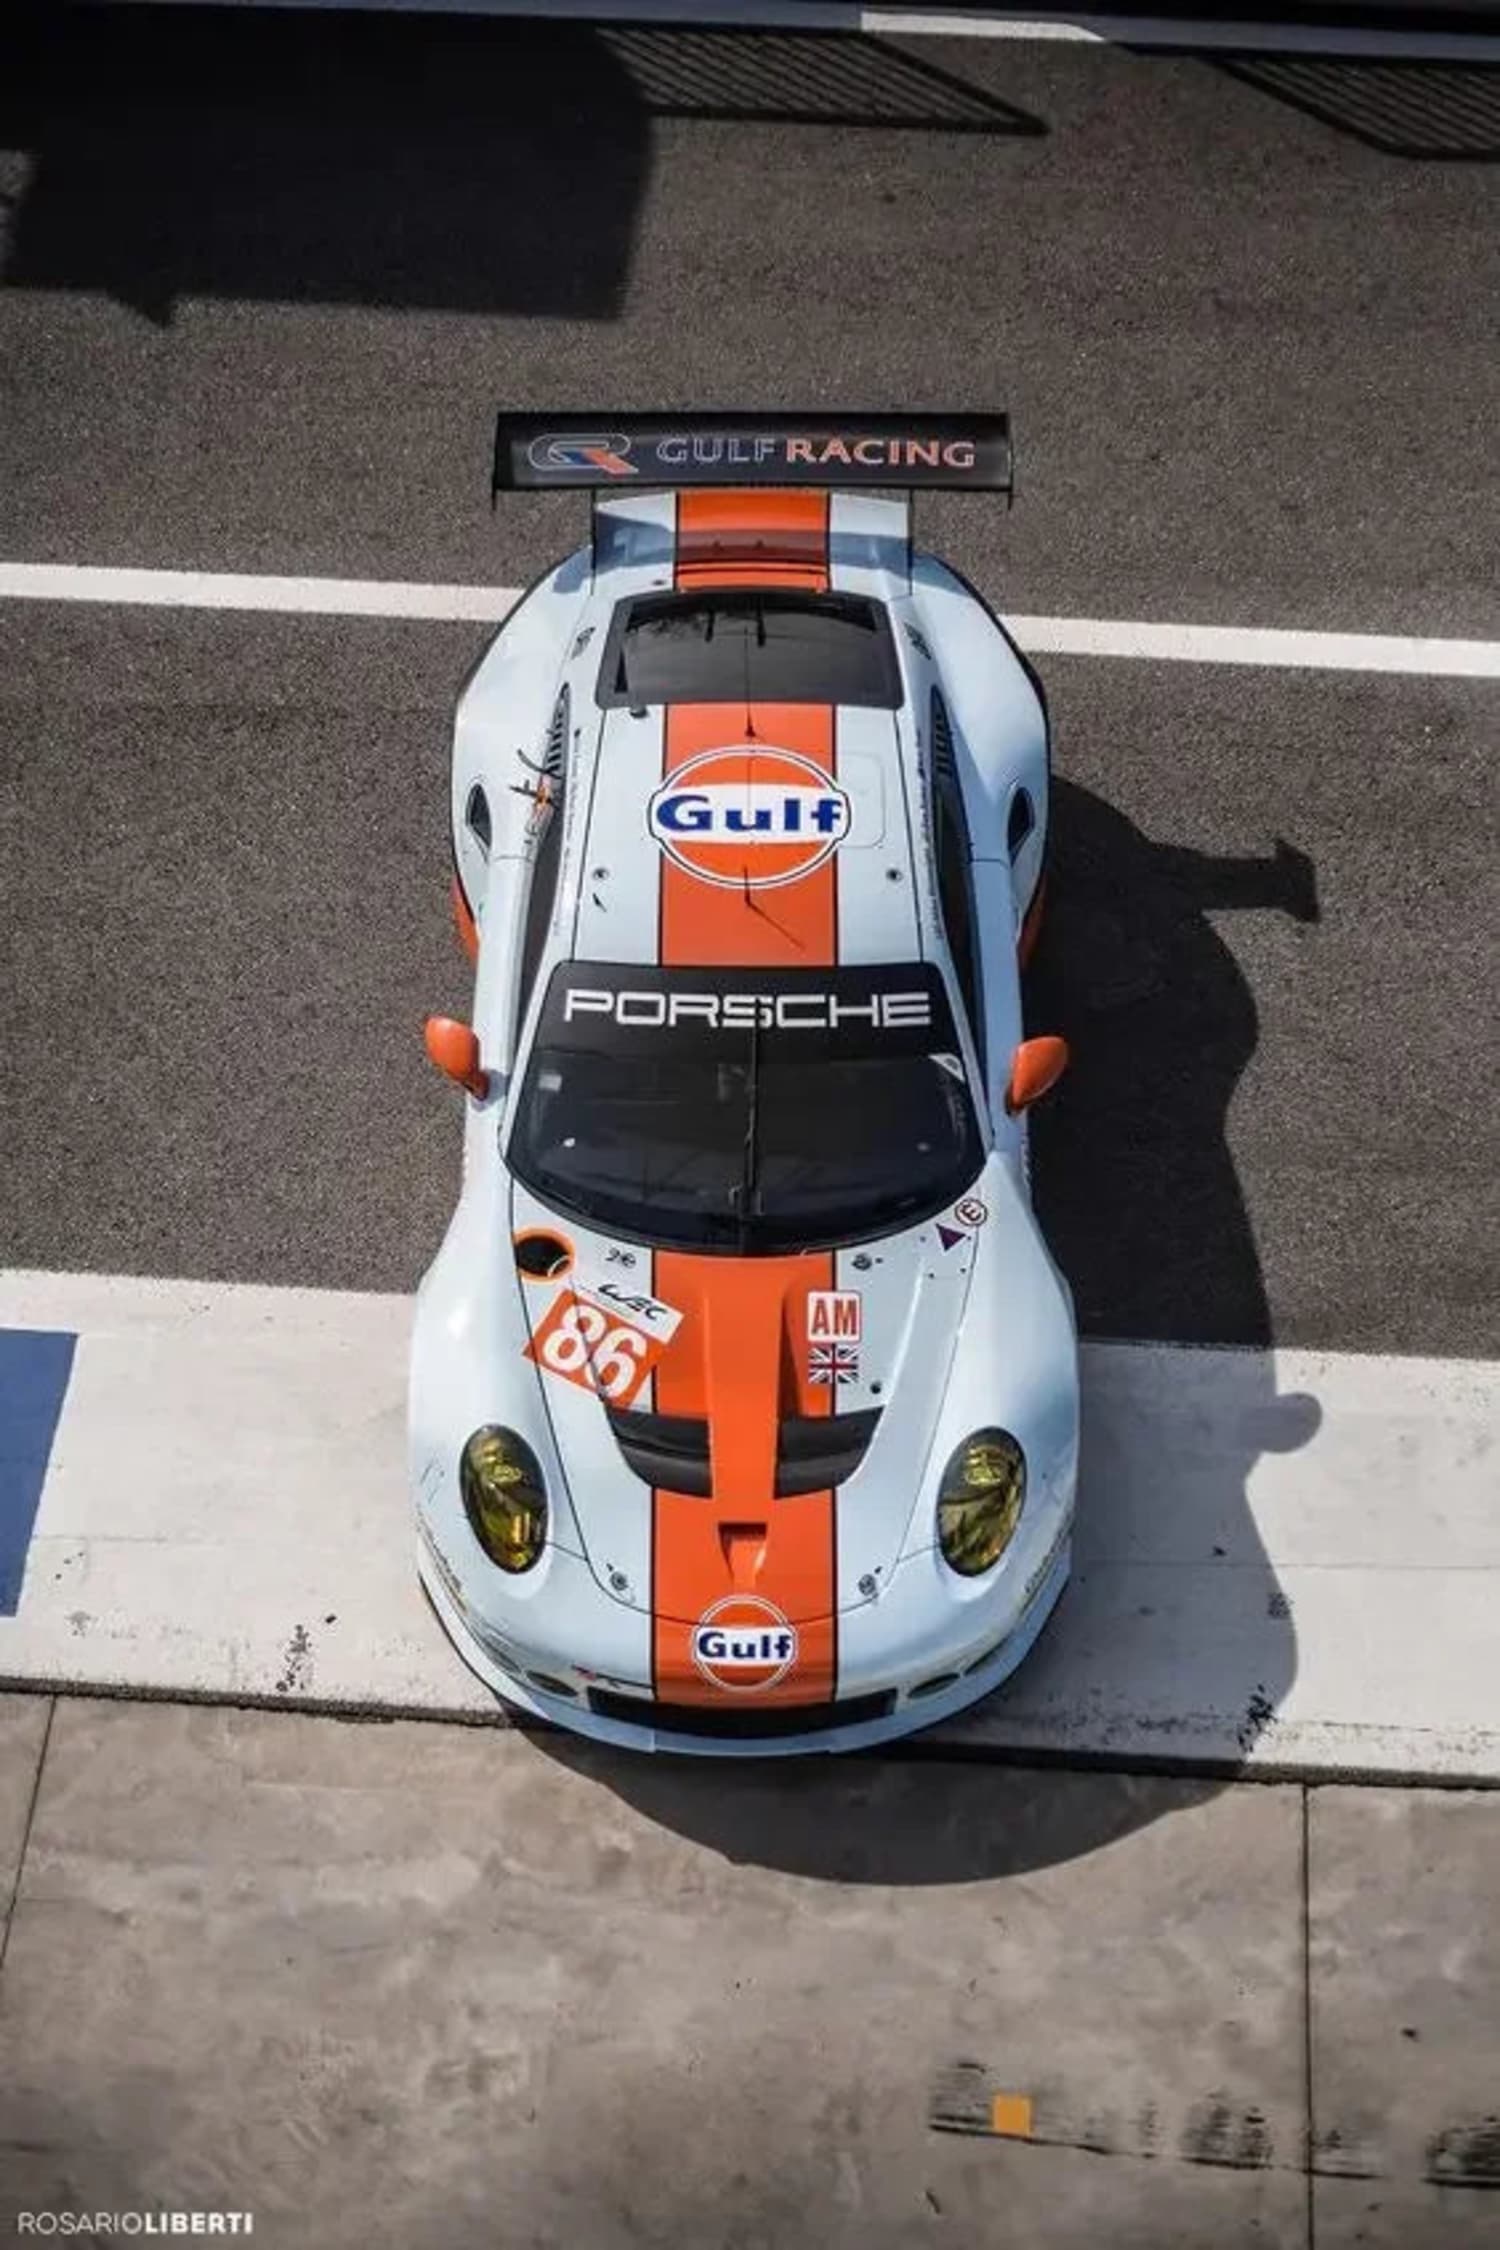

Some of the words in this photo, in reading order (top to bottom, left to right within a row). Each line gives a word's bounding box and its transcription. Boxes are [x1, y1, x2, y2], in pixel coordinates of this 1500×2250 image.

[656, 795, 842, 832] Gulf
[564, 988, 931, 1028] PORSCHE
[810, 1297, 858, 1337] AM
[542, 1304, 648, 1399] 86
[698, 1631, 791, 1659] Gulf
